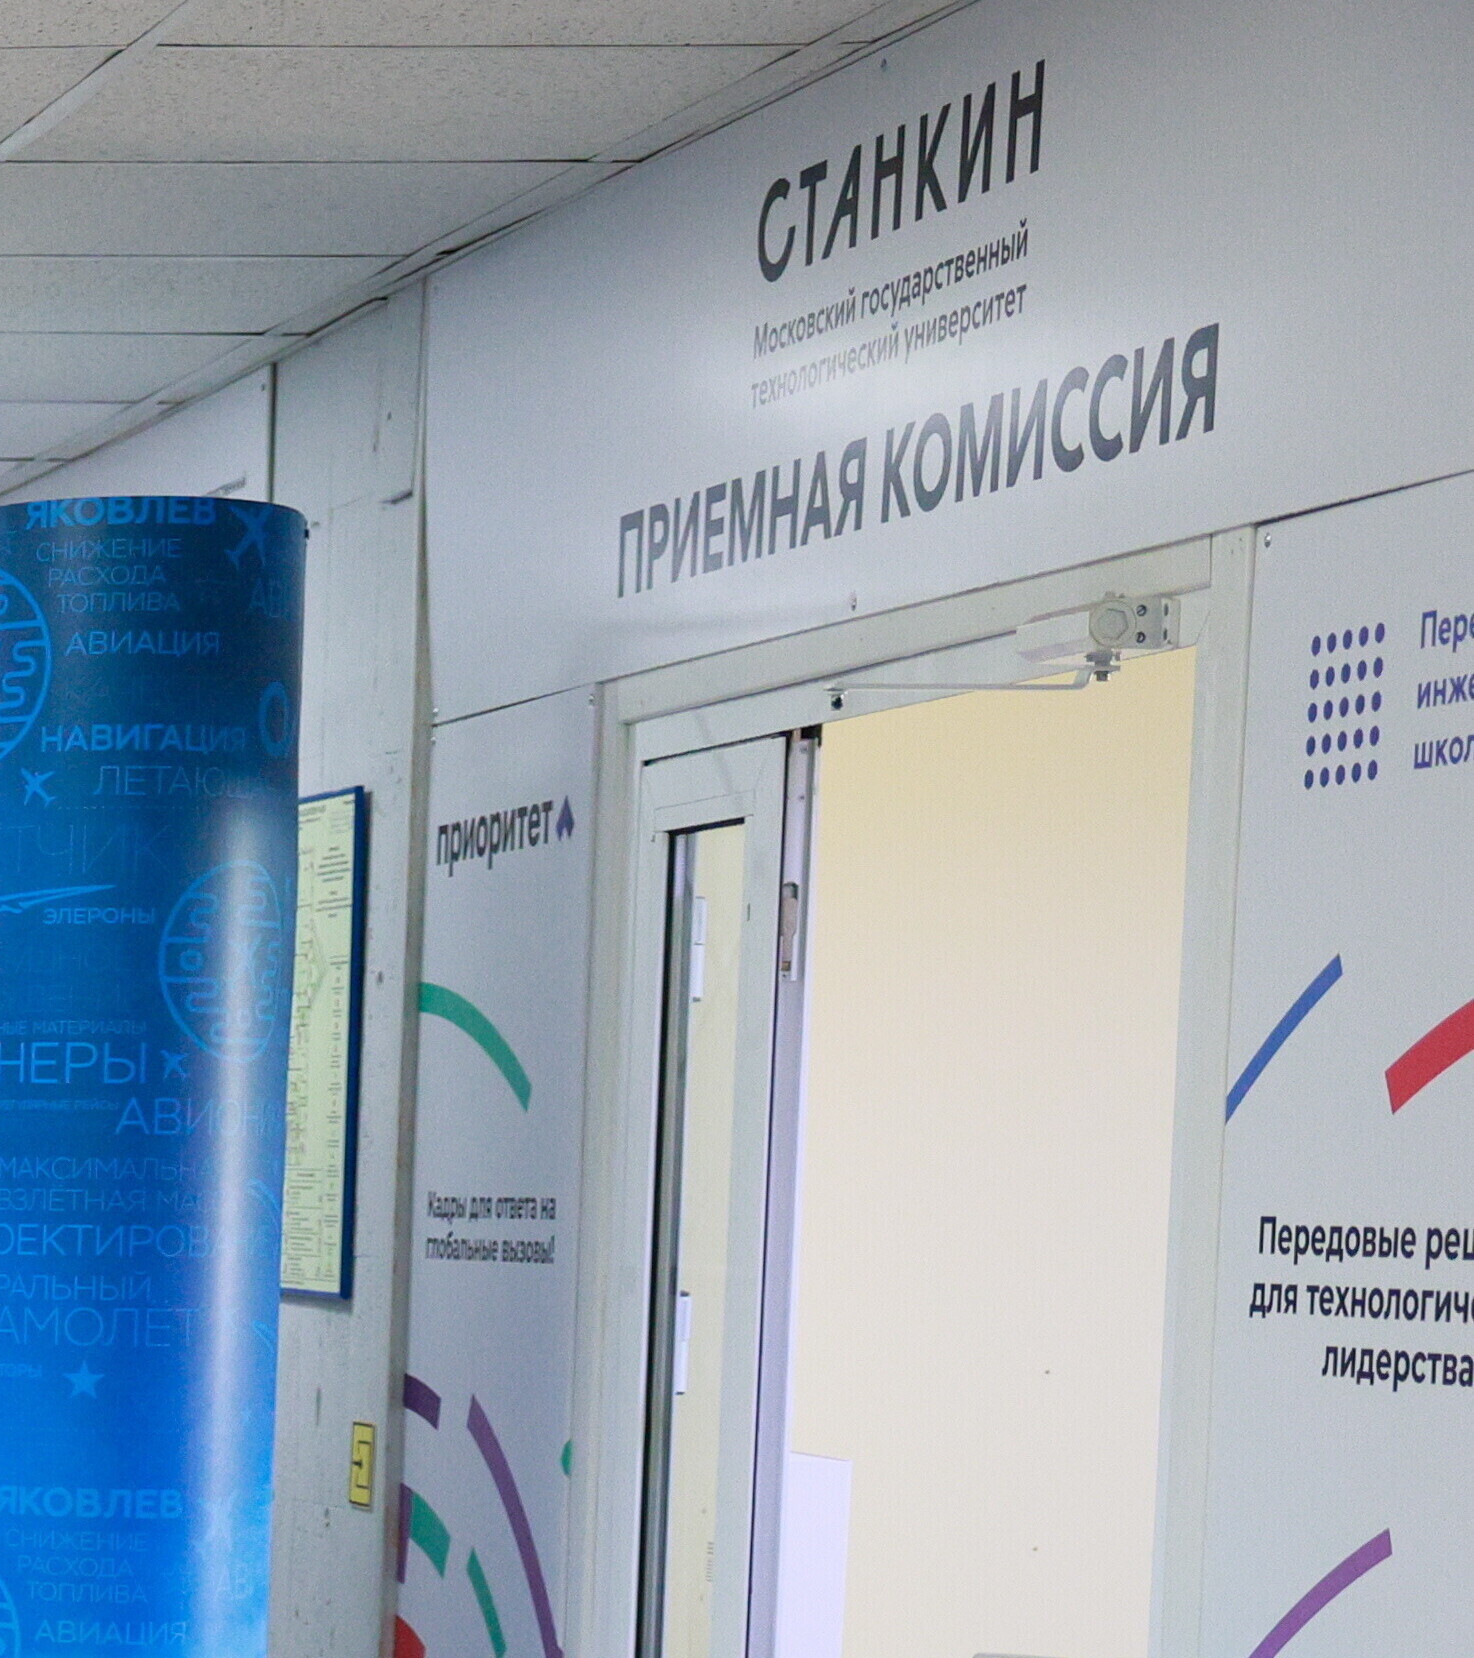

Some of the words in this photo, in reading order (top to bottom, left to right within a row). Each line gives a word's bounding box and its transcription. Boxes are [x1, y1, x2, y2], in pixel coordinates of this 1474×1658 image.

[757, 59, 1046, 283] СТАНКИН
[753, 288, 857, 361] Московский
[860, 218, 1029, 323] государственный
[750, 321, 900, 410] технологический
[903, 285, 1028, 365] университет
[617, 436, 868, 599] ПРИЕМНАЯ
[880, 322, 1221, 524] КОМИССИЯ
[36, 538, 183, 563] СНИЖЕНИЕ
[48, 564, 167, 588] РАСХОДА
[64, 630, 221, 658] АВИАЦИЯ
[40, 723, 247, 755] НАВИГАЦИЯ
[436, 800, 554, 877] приоритет
[42, 906, 156, 926] ЭЛЕРОНЫ
[540, 1198, 555, 1220] на
[1258, 1216, 1417, 1265] Передовые
[1249, 1283, 1298, 1319] для
[1306, 1285, 1474, 1324] технологич
[1321, 1346, 1474, 1392] лидерства
[5, 1528, 149, 1553] СНИЖЕНИЕ
[16, 1554, 134, 1578] РАСХОДА
[34, 1619, 187, 1646] АВИАЦИЯ
